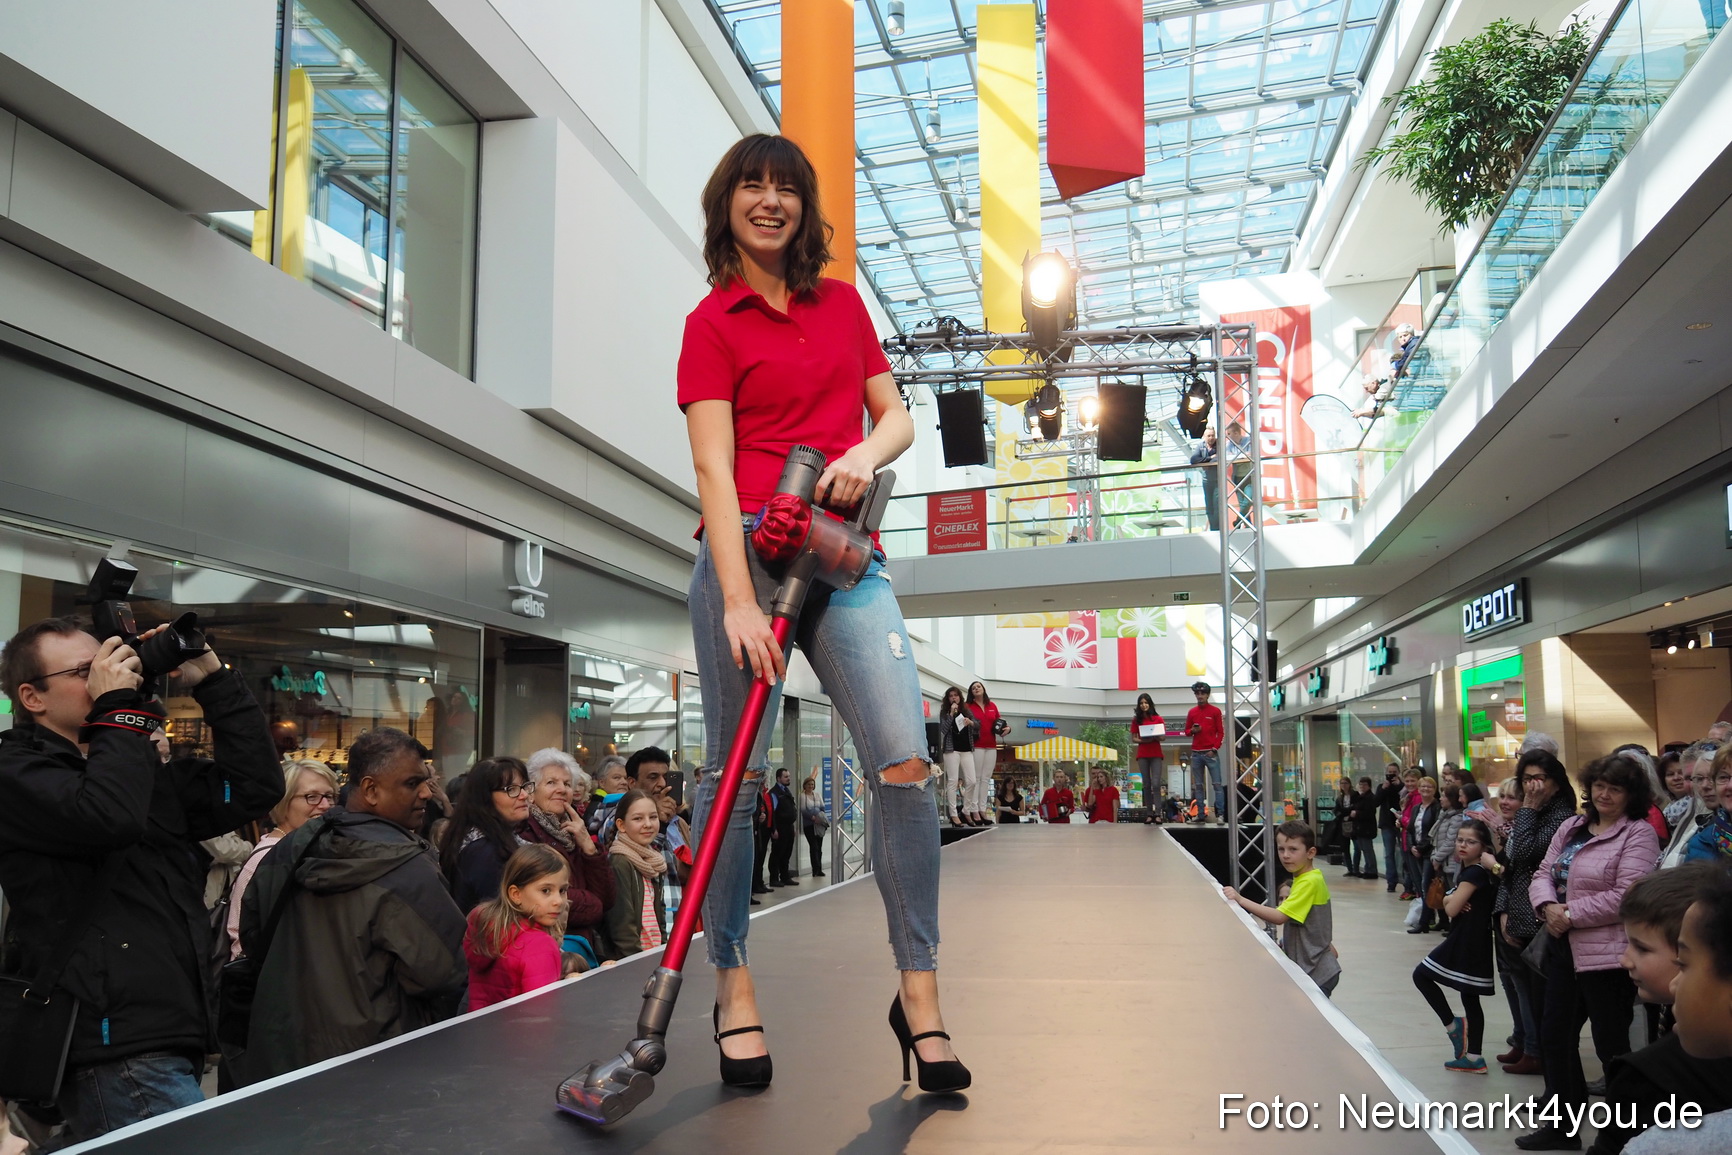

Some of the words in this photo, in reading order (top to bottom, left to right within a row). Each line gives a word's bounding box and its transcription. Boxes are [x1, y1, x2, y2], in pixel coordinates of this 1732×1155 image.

[933, 522, 979, 535] CINEPLEX
[517, 594, 545, 618] eins
[1462, 583, 1515, 633] DEPOT
[115, 714, 146, 727] EOS
